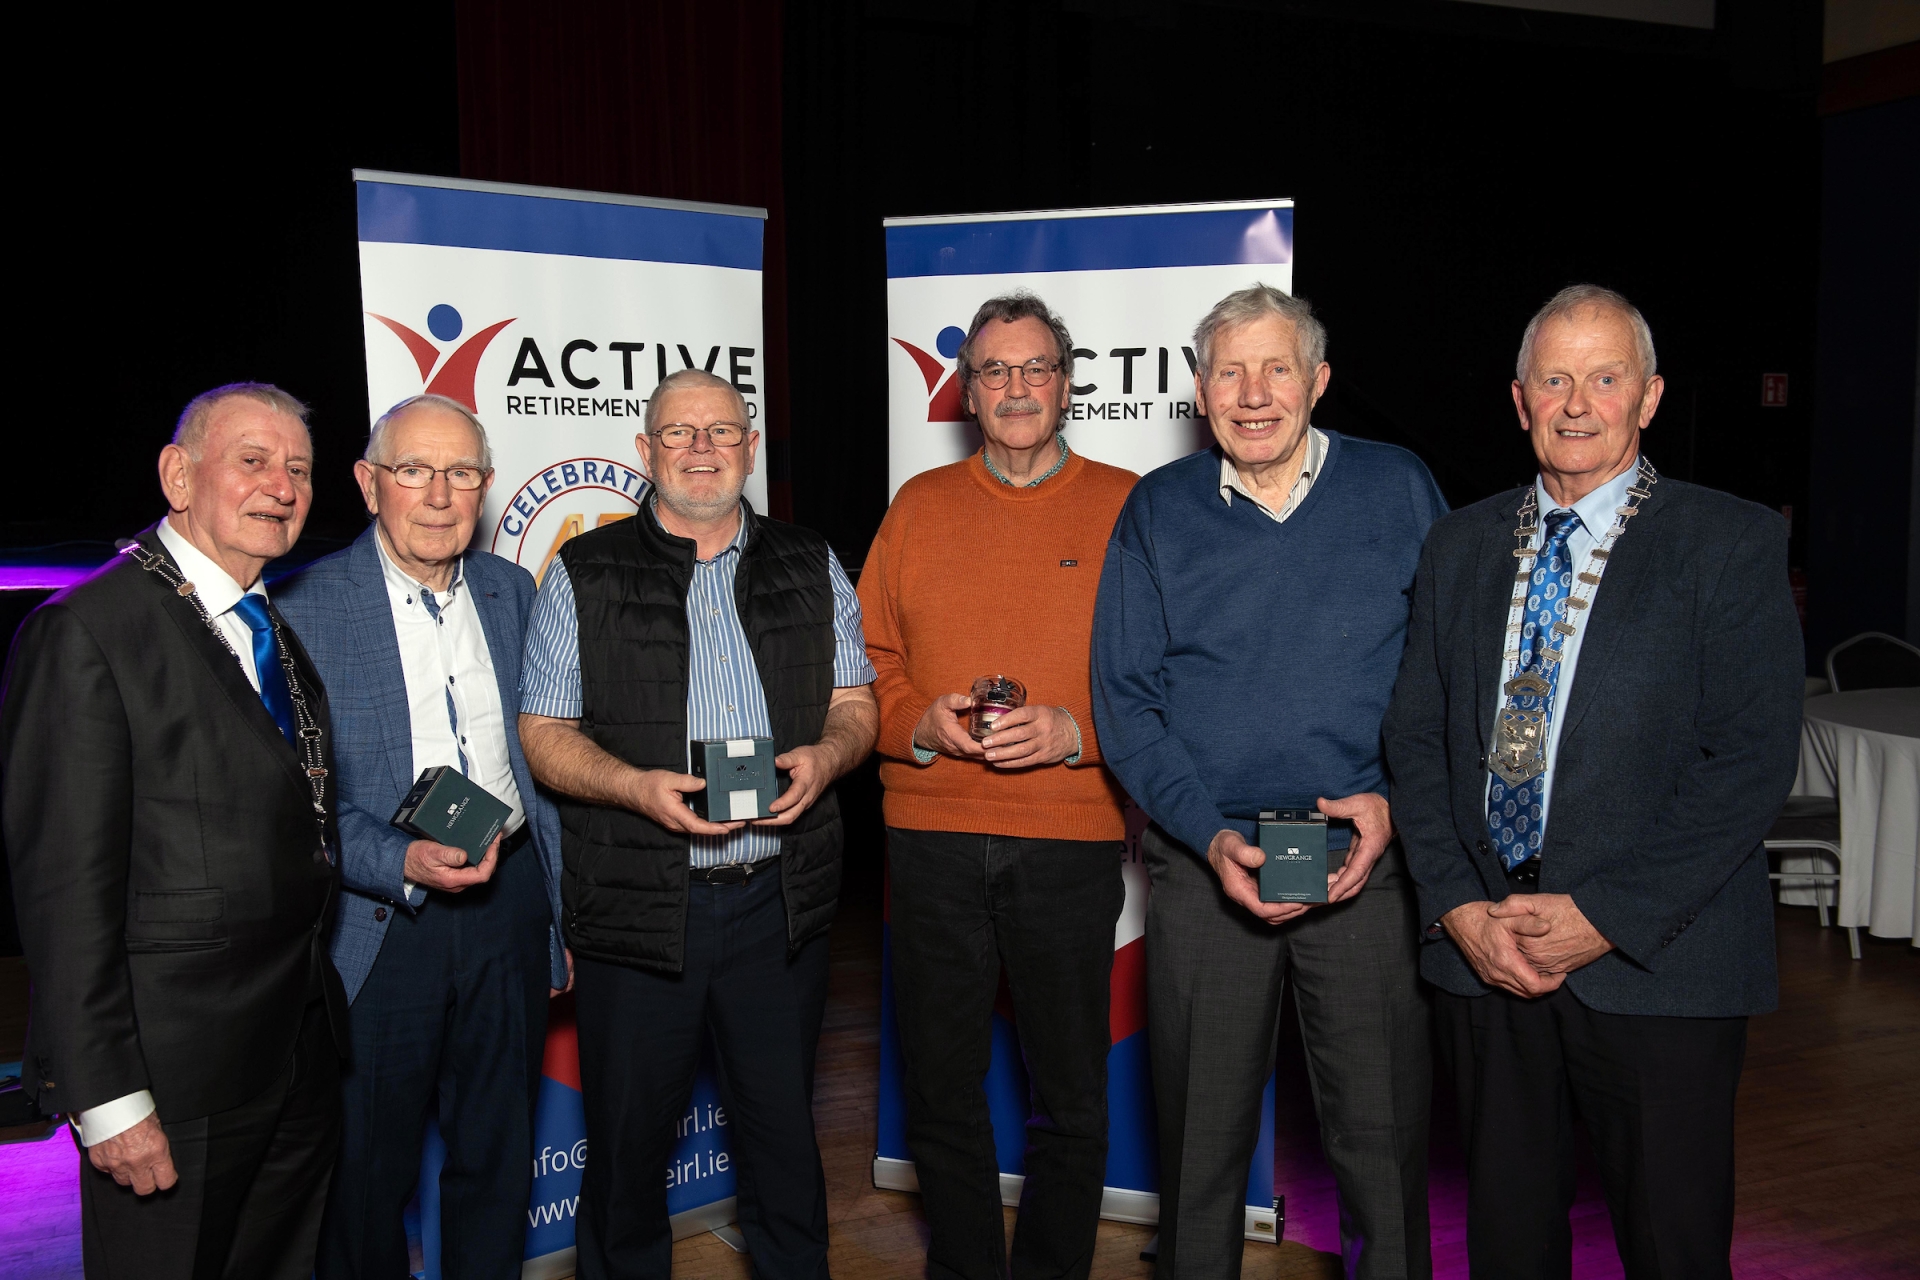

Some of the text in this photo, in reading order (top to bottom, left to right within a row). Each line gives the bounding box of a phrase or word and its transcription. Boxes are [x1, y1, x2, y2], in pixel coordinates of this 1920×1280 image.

[507, 337, 757, 394] ACTIVE
[1071, 346, 1198, 396] CTI
[1064, 402, 1154, 420] EMENT
[502, 460, 649, 538] CELEBRATI
